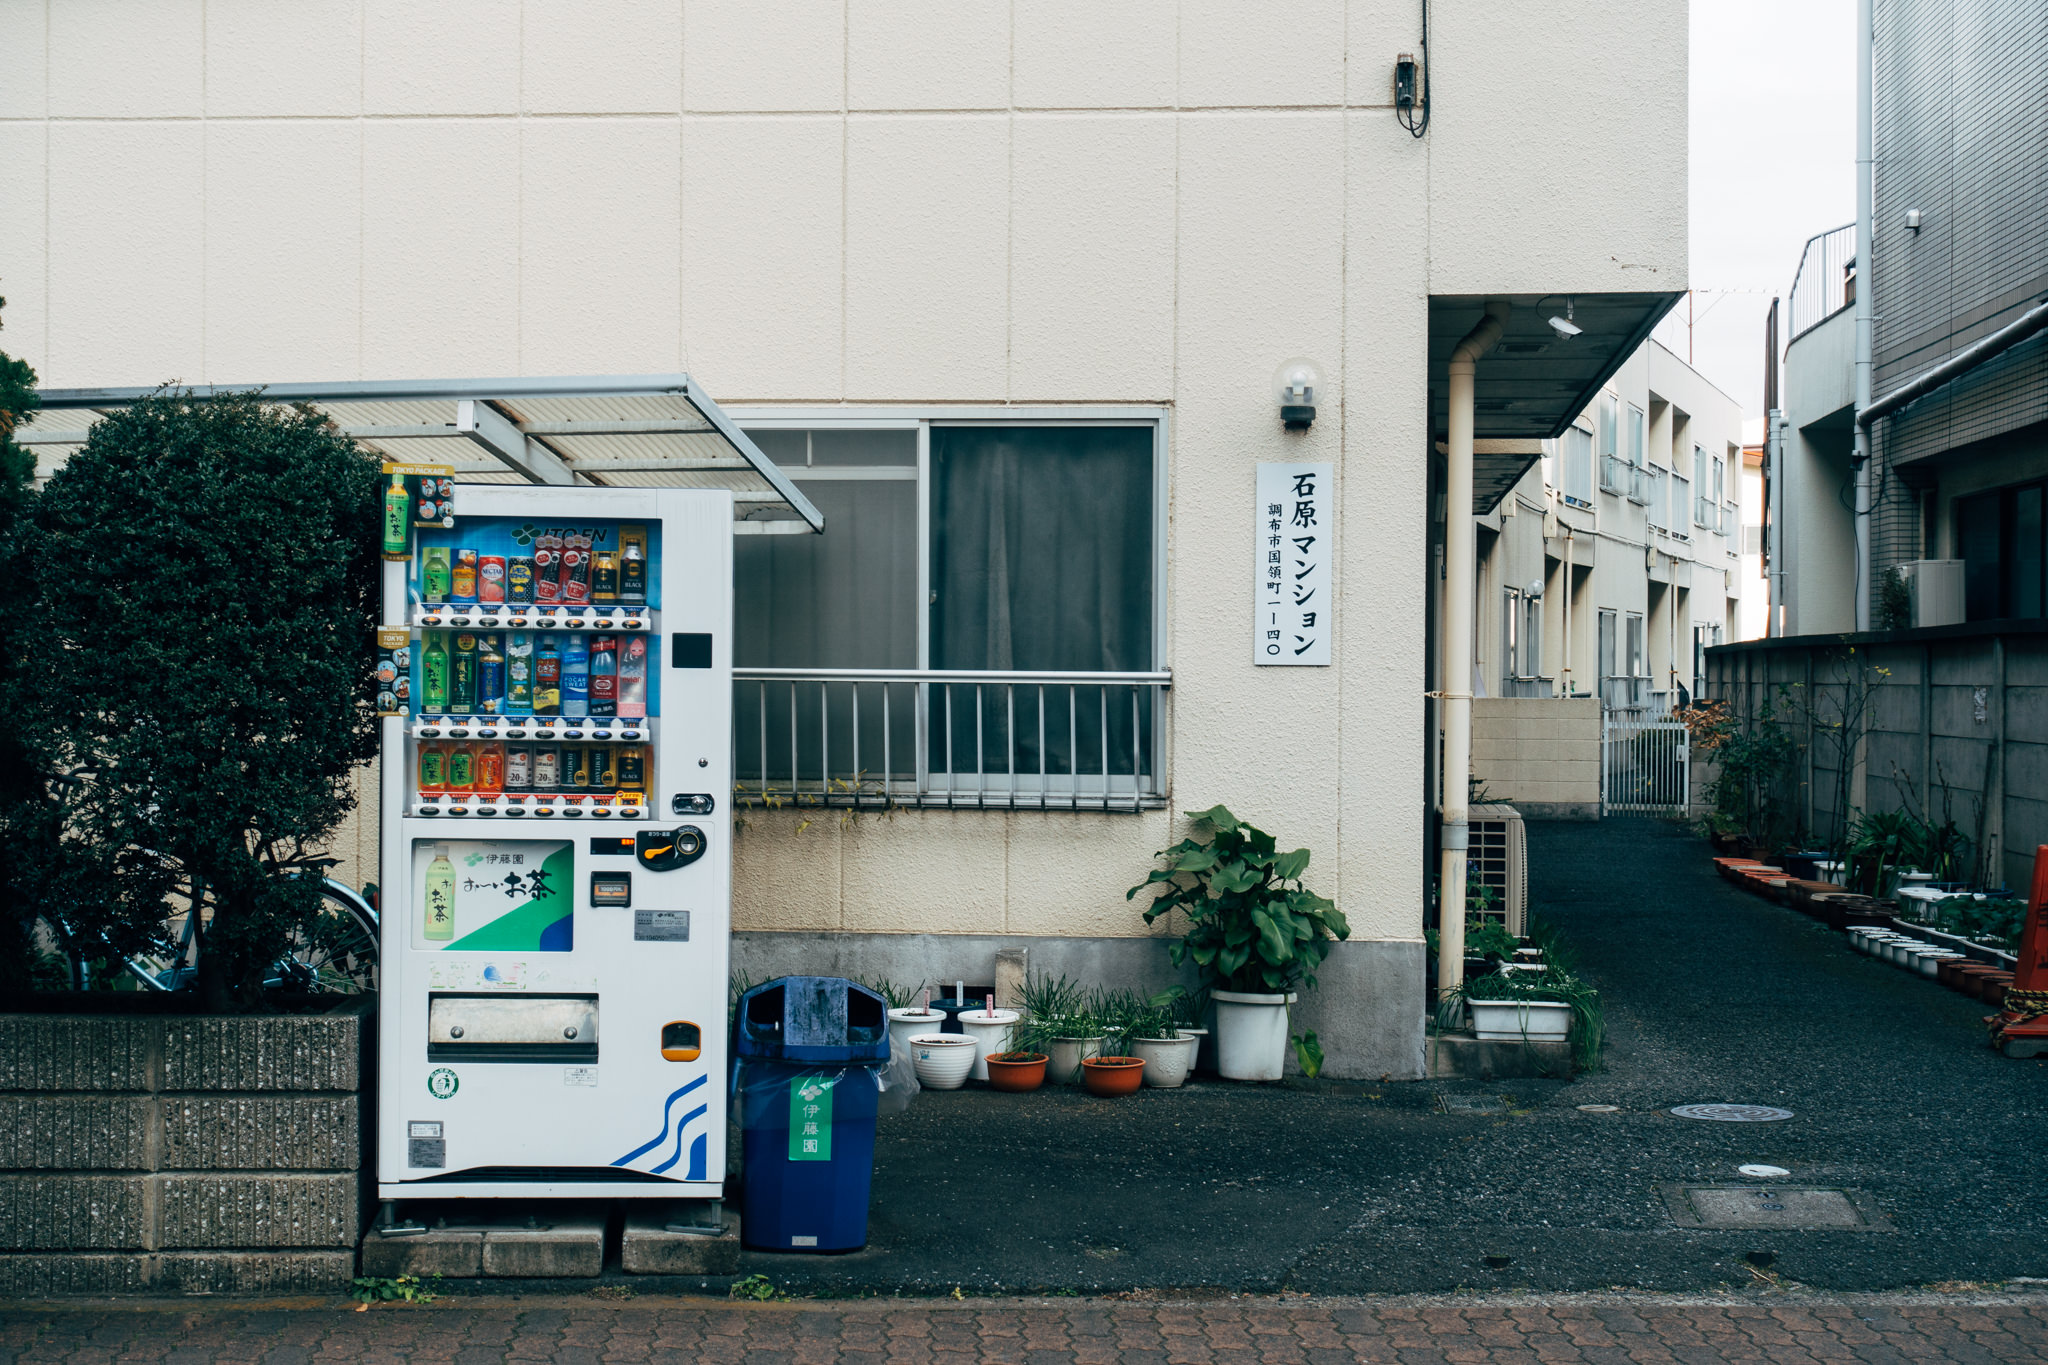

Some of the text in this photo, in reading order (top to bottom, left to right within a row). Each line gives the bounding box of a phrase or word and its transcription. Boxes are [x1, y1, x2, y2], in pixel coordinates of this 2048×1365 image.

[392, 466, 446, 475] TOKYO PACKAGE
[1289, 472, 1318, 656] 石原マンション
[622, 676, 642, 684] evian
[510, 773, 520, 782] 20
[537, 773, 548, 782] 20
[486, 854, 524, 865] 伊藤園
[431, 889, 449, 923] お茶
[802, 1104, 820, 1153] 伊藤園
